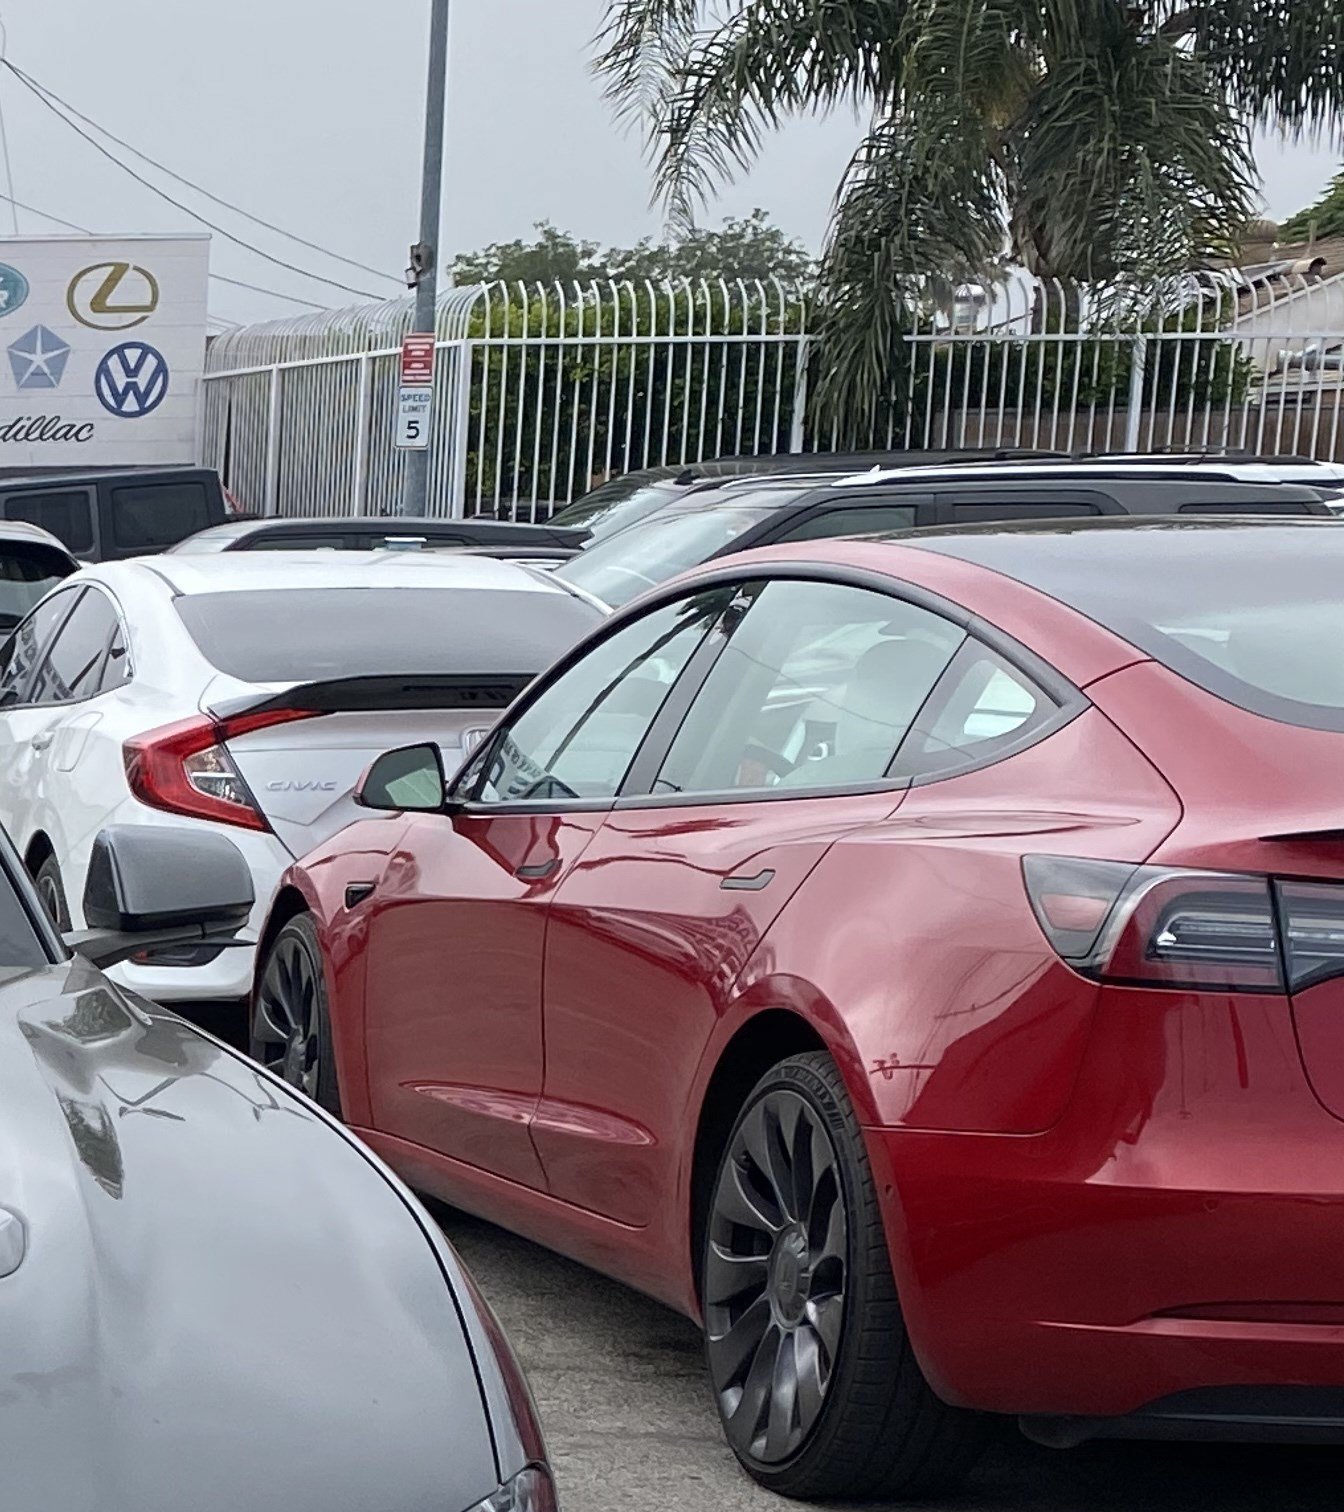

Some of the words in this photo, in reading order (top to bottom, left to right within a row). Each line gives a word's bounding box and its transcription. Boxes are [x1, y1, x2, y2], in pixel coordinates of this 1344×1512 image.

[401, 394, 431, 402] SPEED
[403, 405, 427, 413] LIMIT
[406, 420, 420, 439] 5
[266, 780, 338, 792] CIVIC
